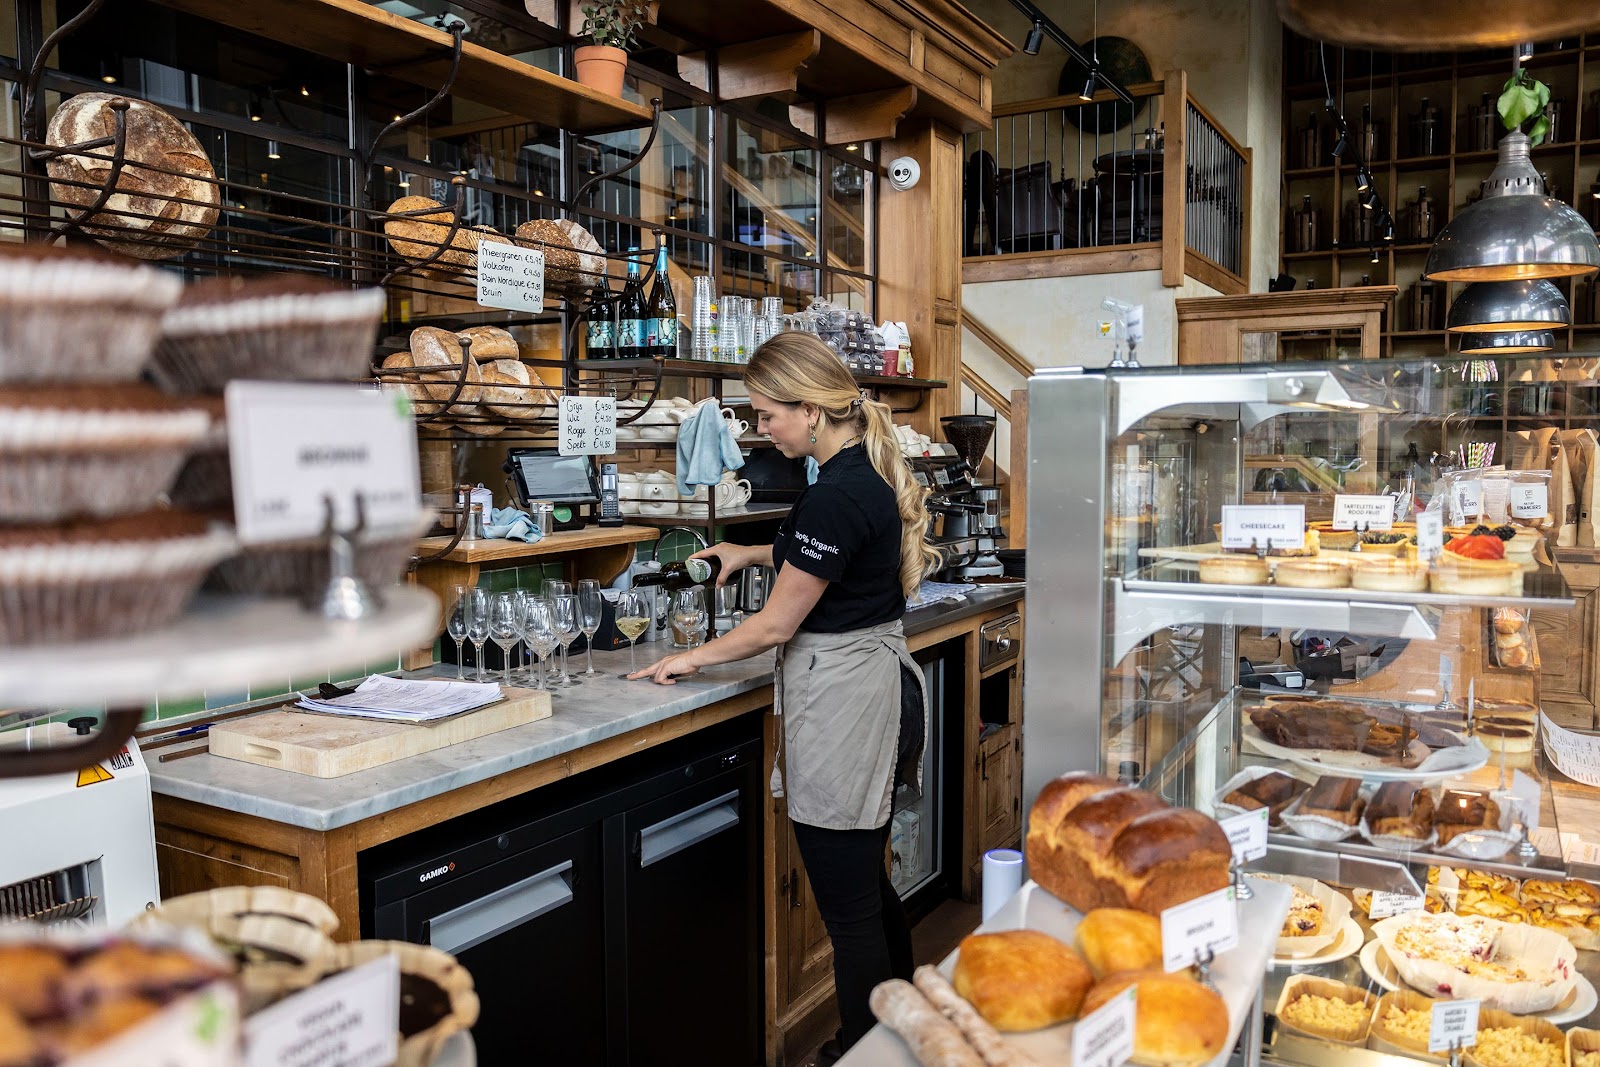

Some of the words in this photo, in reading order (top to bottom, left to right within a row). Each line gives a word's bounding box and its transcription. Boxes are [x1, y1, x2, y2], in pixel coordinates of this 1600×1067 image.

[481, 286, 502, 298] Bruin
[567, 399, 583, 414] Grijs
[567, 425, 587, 439] Rogge
[567, 438, 587, 451] Spelt
[1240, 522, 1286, 530] CHEESECAKE
[801, 545, 823, 561] Cotton
[810, 537, 840, 555] Organic
[419, 865, 449, 883] GAMKO
